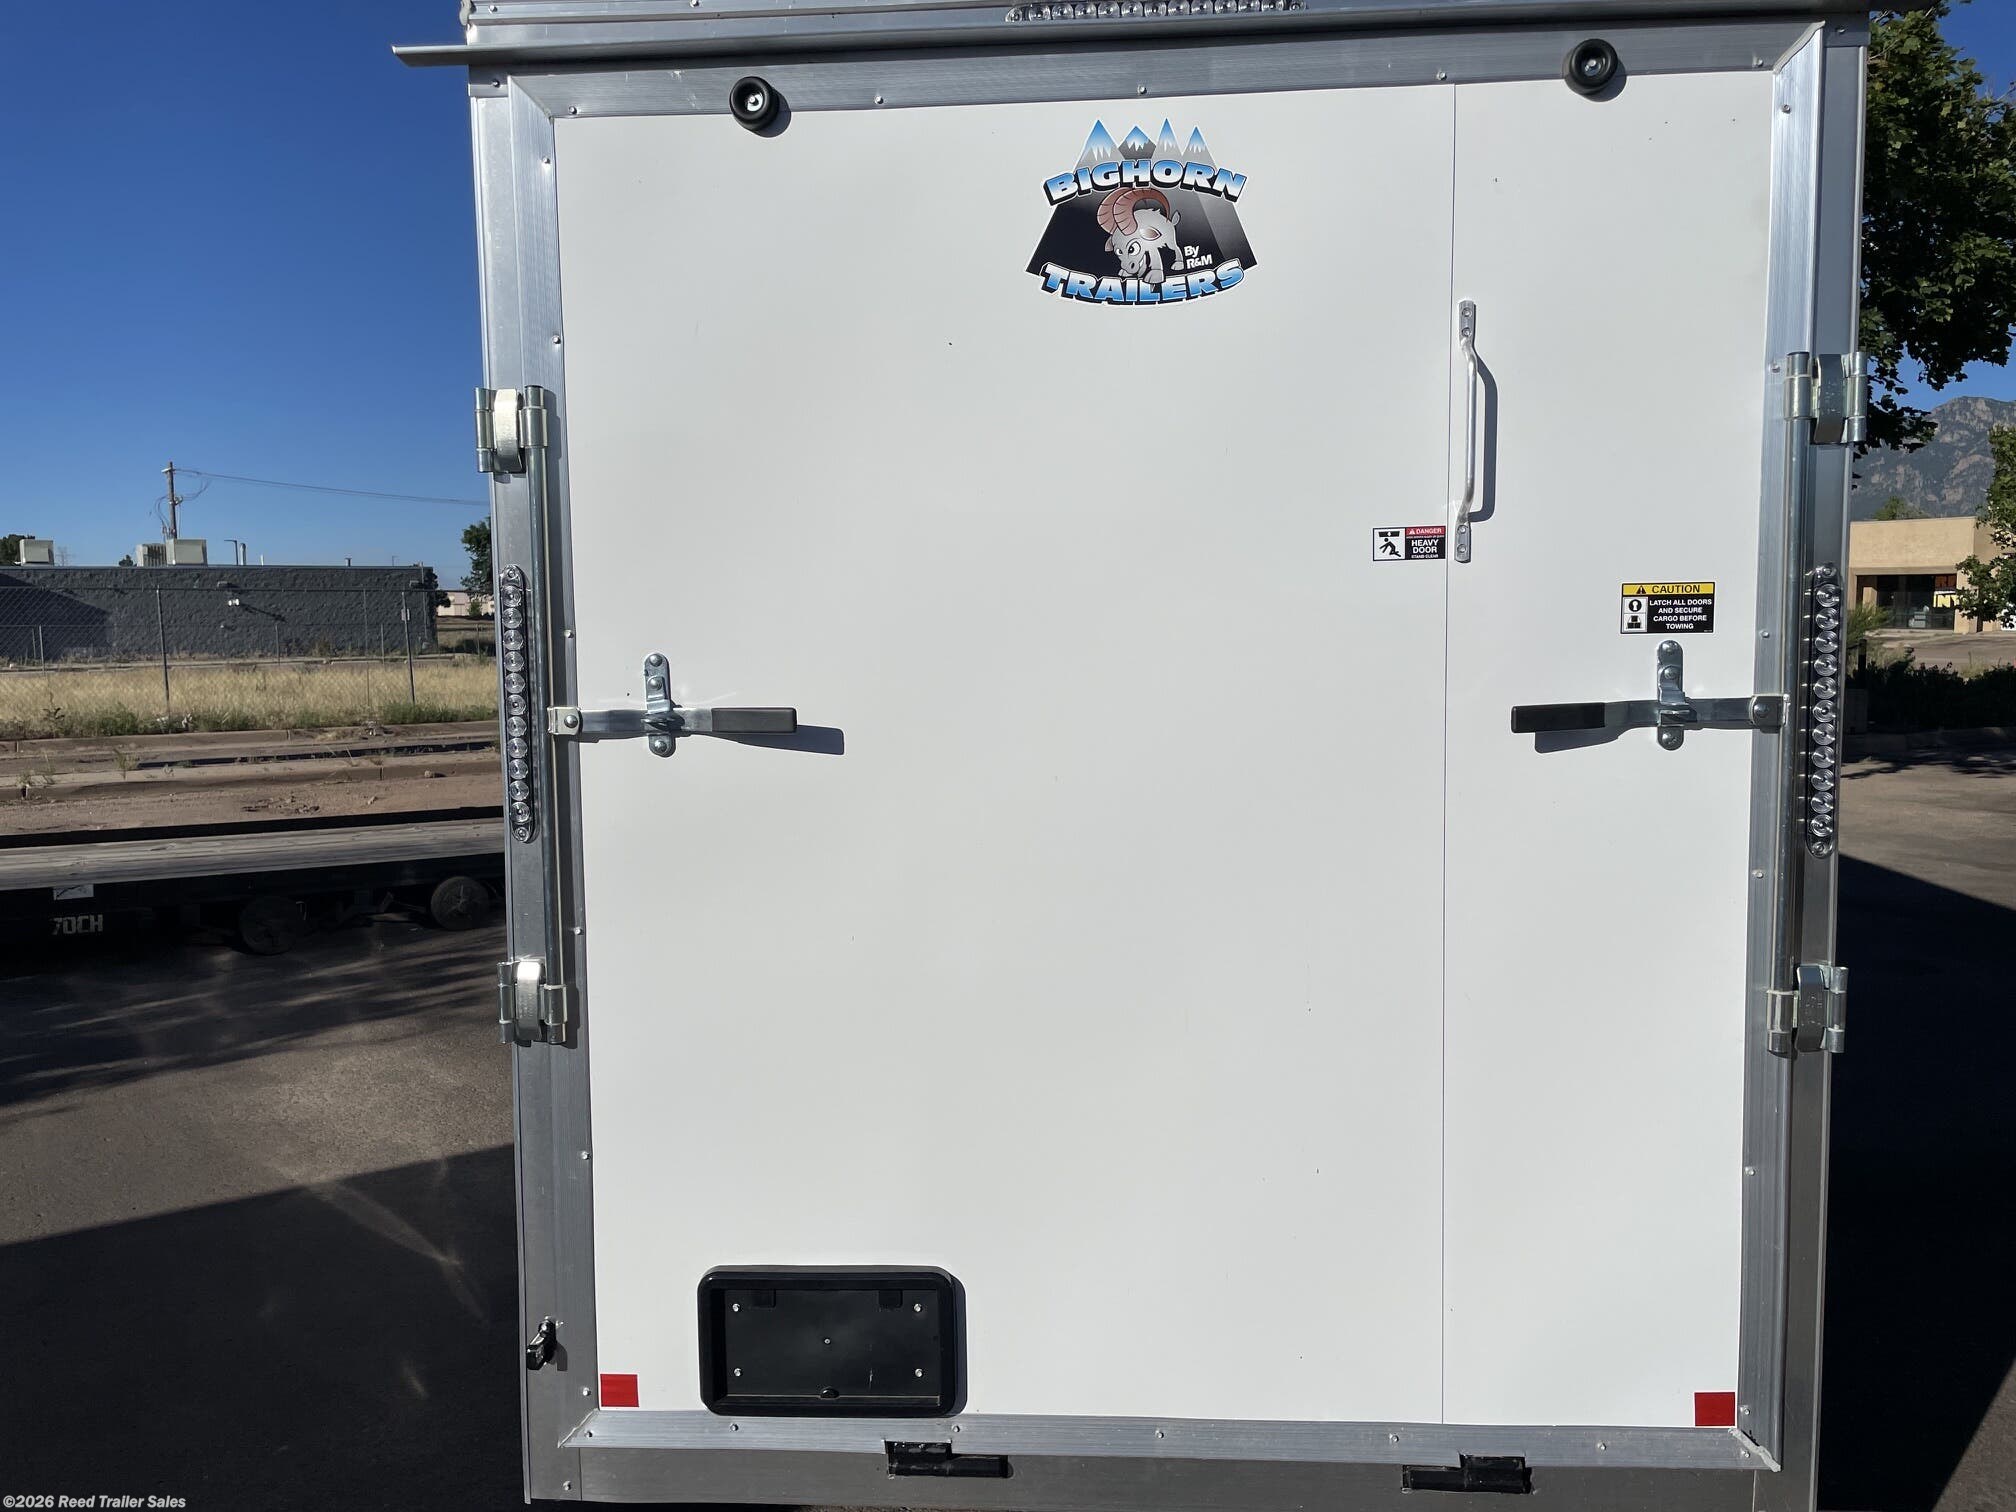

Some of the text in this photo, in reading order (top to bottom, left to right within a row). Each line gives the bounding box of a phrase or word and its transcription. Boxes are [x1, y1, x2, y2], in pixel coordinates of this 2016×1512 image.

[1043, 159, 1248, 206] BIGHORN
[1184, 245, 1200, 258] By
[1186, 254, 1213, 269] R&M
[1041, 258, 1245, 305] TRAILERS
[1411, 539, 1439, 547] HEAVY
[1412, 546, 1438, 554] DOOR
[1651, 584, 1700, 594] CAUTION
